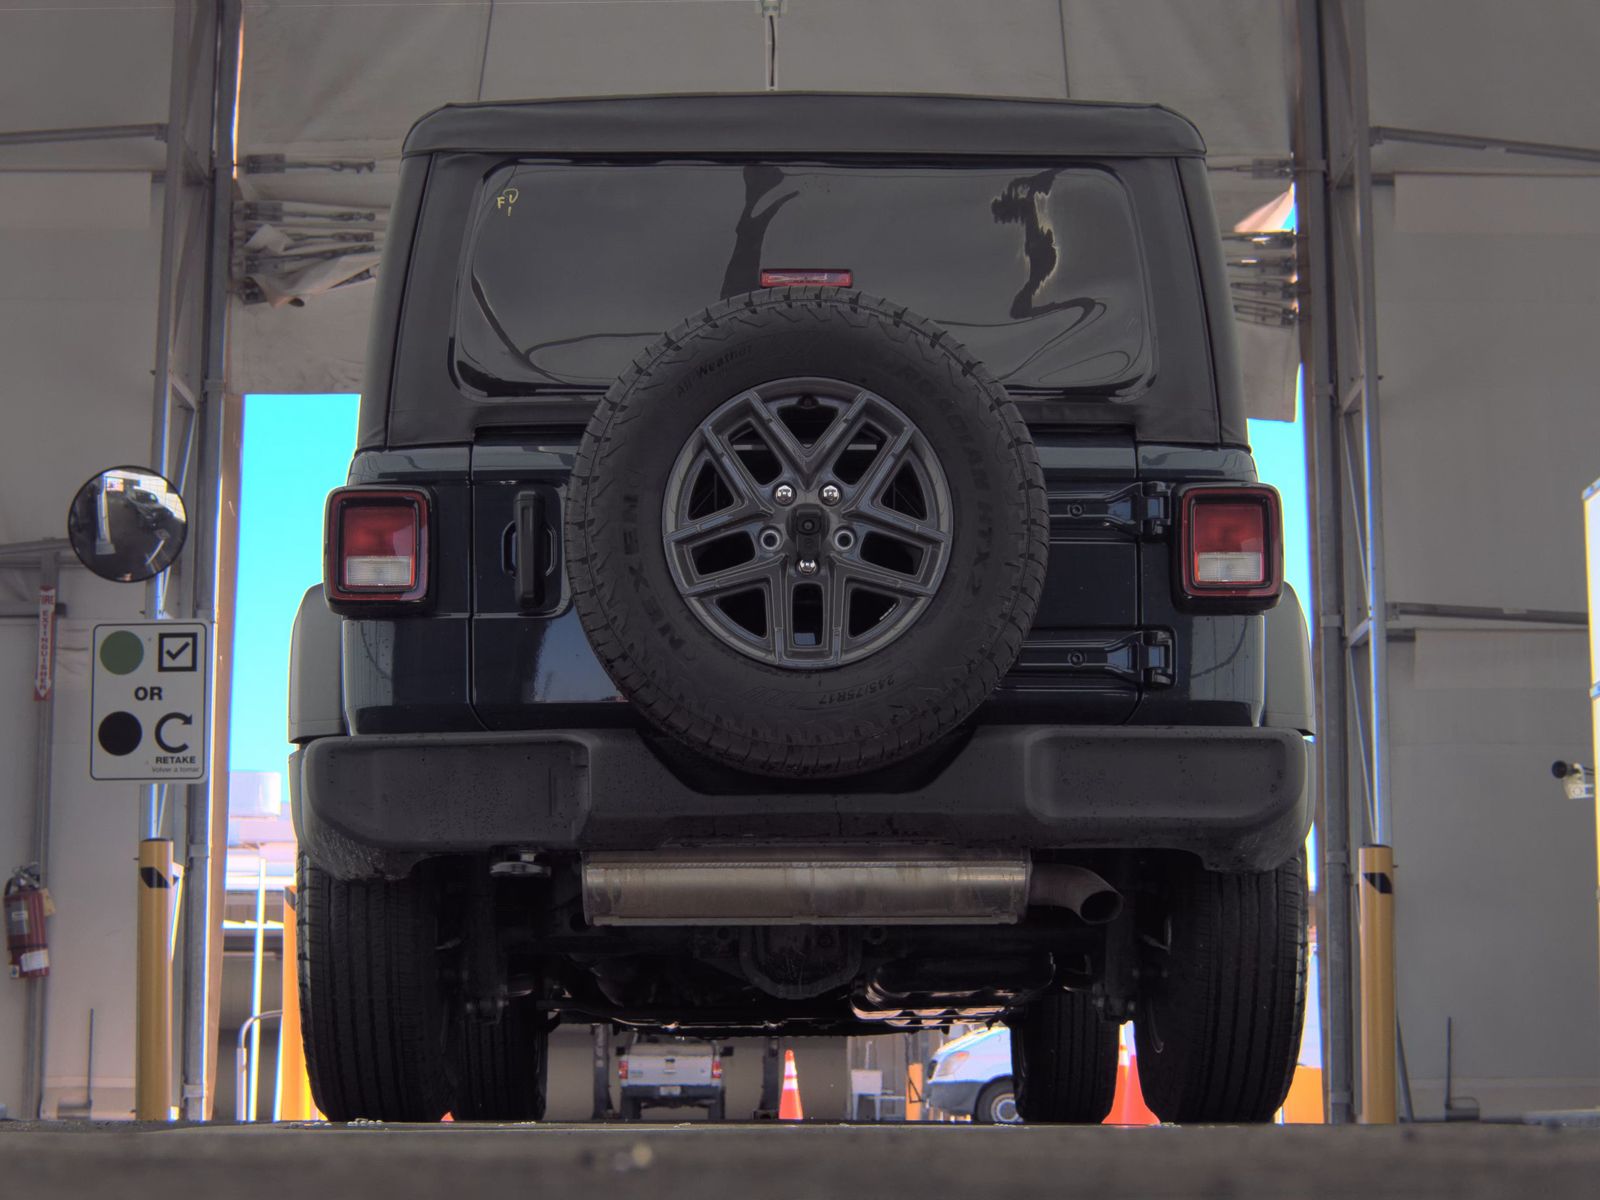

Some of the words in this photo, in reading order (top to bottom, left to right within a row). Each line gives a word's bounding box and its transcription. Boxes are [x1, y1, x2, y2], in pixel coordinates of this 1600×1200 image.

[620, 493, 687, 650] NEXEN
[134, 686, 164, 702] OR
[155, 755, 197, 764] RETAKE
